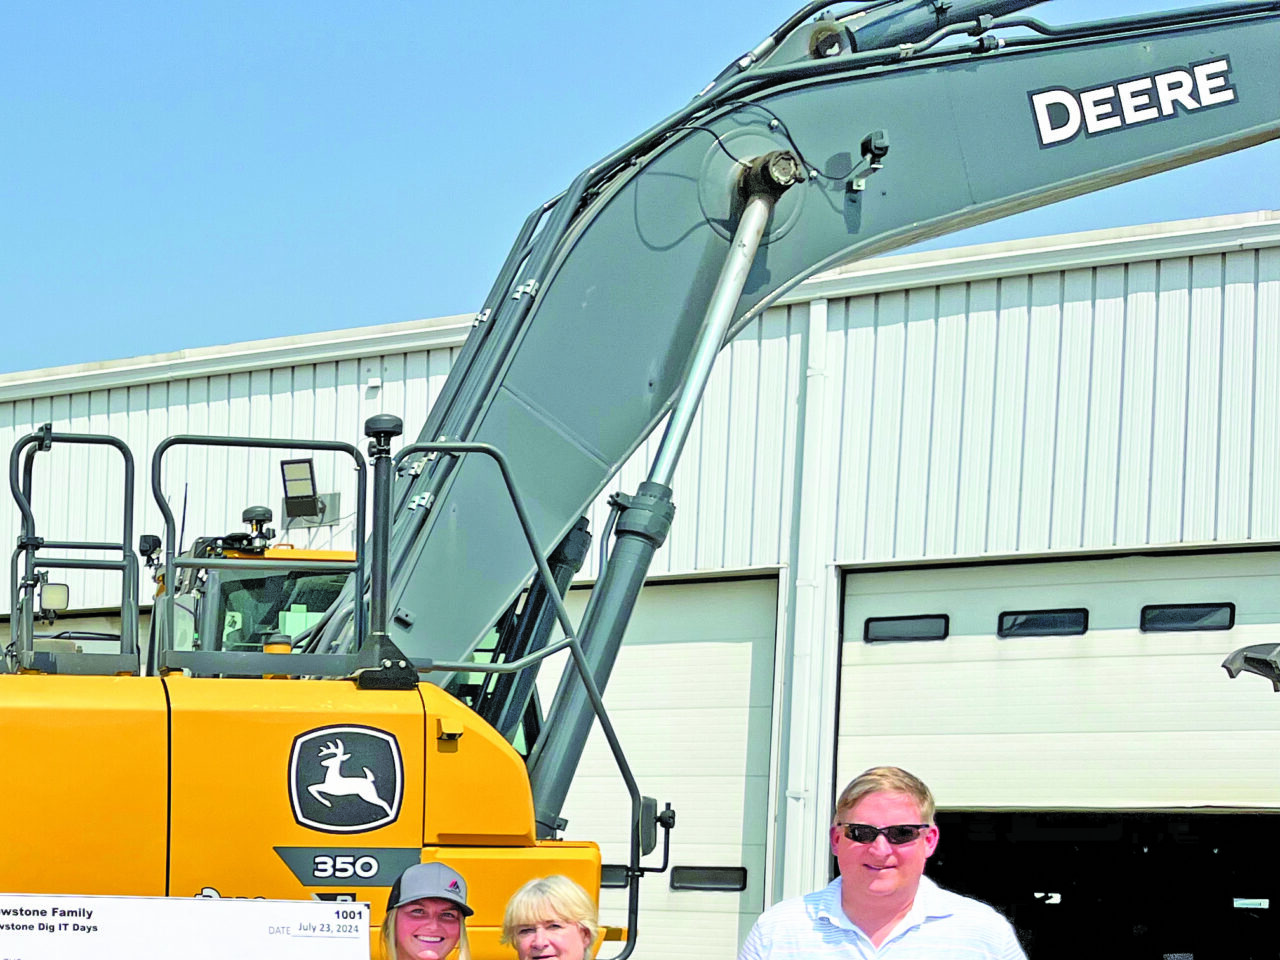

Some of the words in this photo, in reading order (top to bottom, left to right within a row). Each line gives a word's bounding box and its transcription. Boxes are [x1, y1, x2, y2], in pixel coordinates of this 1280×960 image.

[1032, 59, 1235, 146] DEERE
[313, 855, 379, 878] 350
[52, 906, 94, 919] Family
[334, 910, 363, 920] 1001
[38, 922, 55, 933] Dig
[58, 922, 69, 931] IT
[72, 923, 98, 933] Days
[268, 926, 292, 935] DATE
[298, 922, 317, 934] July
[319, 923, 333, 934] 23,
[336, 924, 359, 933] 2024
